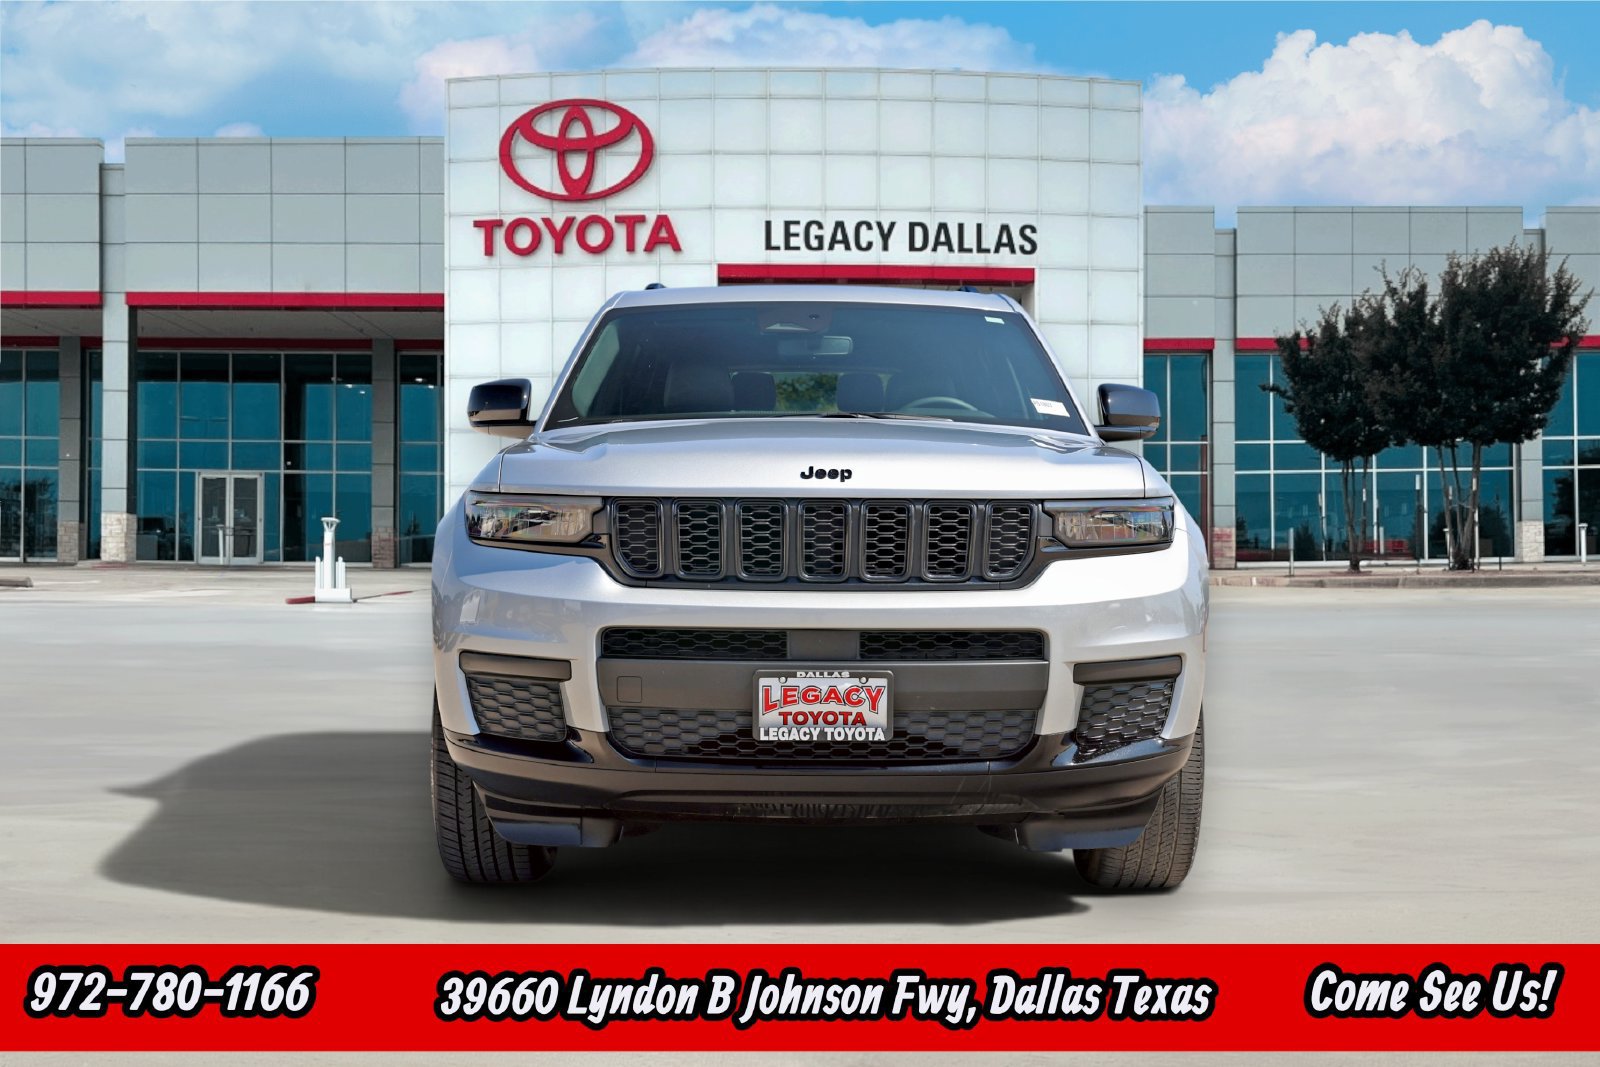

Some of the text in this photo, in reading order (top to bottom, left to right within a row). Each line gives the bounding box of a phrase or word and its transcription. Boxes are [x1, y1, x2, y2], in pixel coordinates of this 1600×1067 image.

[473, 213, 682, 257] TOYOTA
[764, 219, 1038, 255] LEGACY DALLAS
[800, 465, 852, 482] Jeep
[762, 685, 886, 715] LEGACY
[778, 711, 867, 726] TOYOTA
[759, 727, 886, 741] LEGACY TOYOTA
